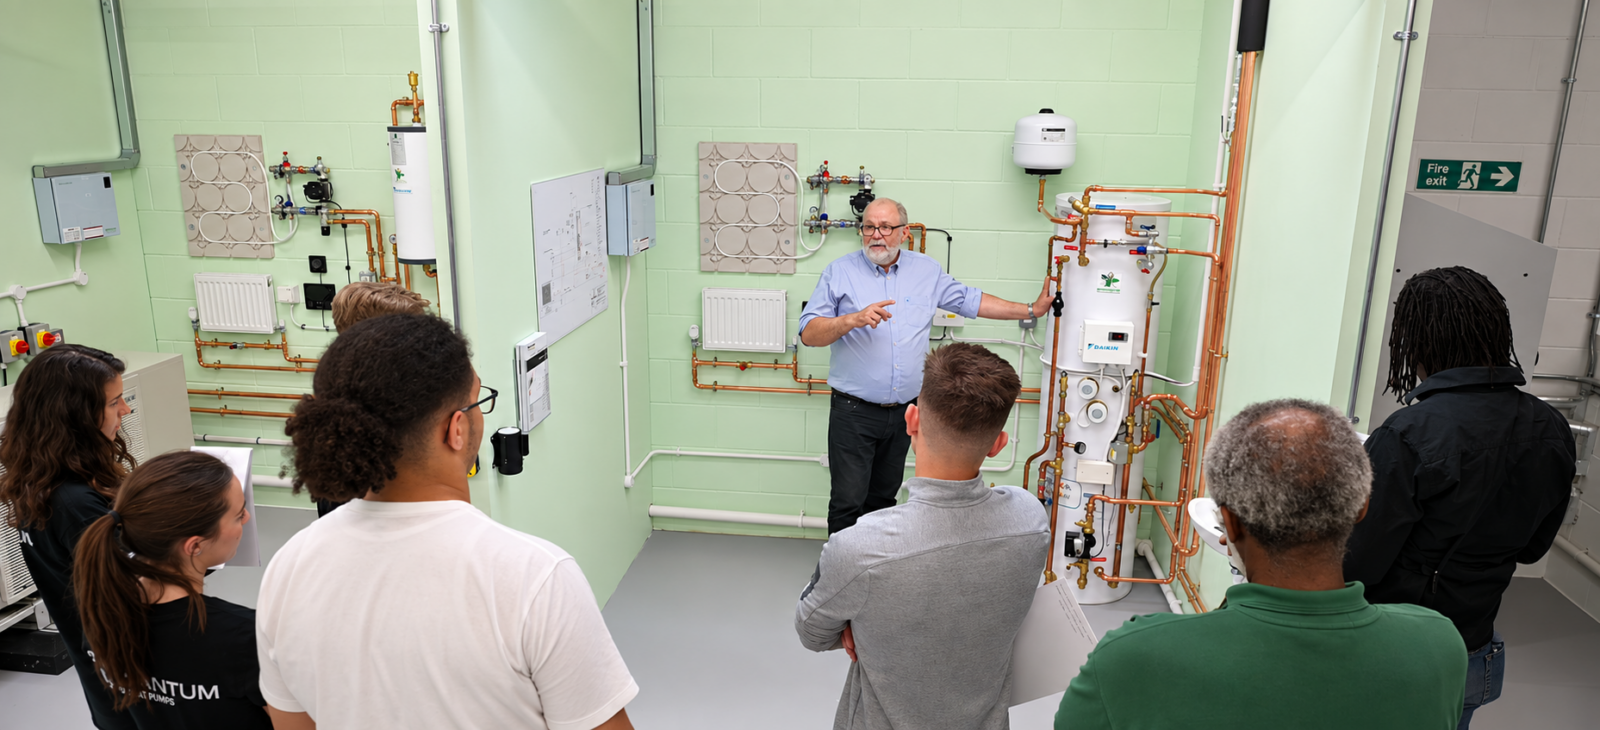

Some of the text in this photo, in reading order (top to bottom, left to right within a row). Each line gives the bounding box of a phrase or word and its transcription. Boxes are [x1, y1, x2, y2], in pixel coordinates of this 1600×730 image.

[1427, 163, 1449, 174] Fire
[1425, 176, 1448, 186] exit
[148, 692, 175, 706] PUMPS
